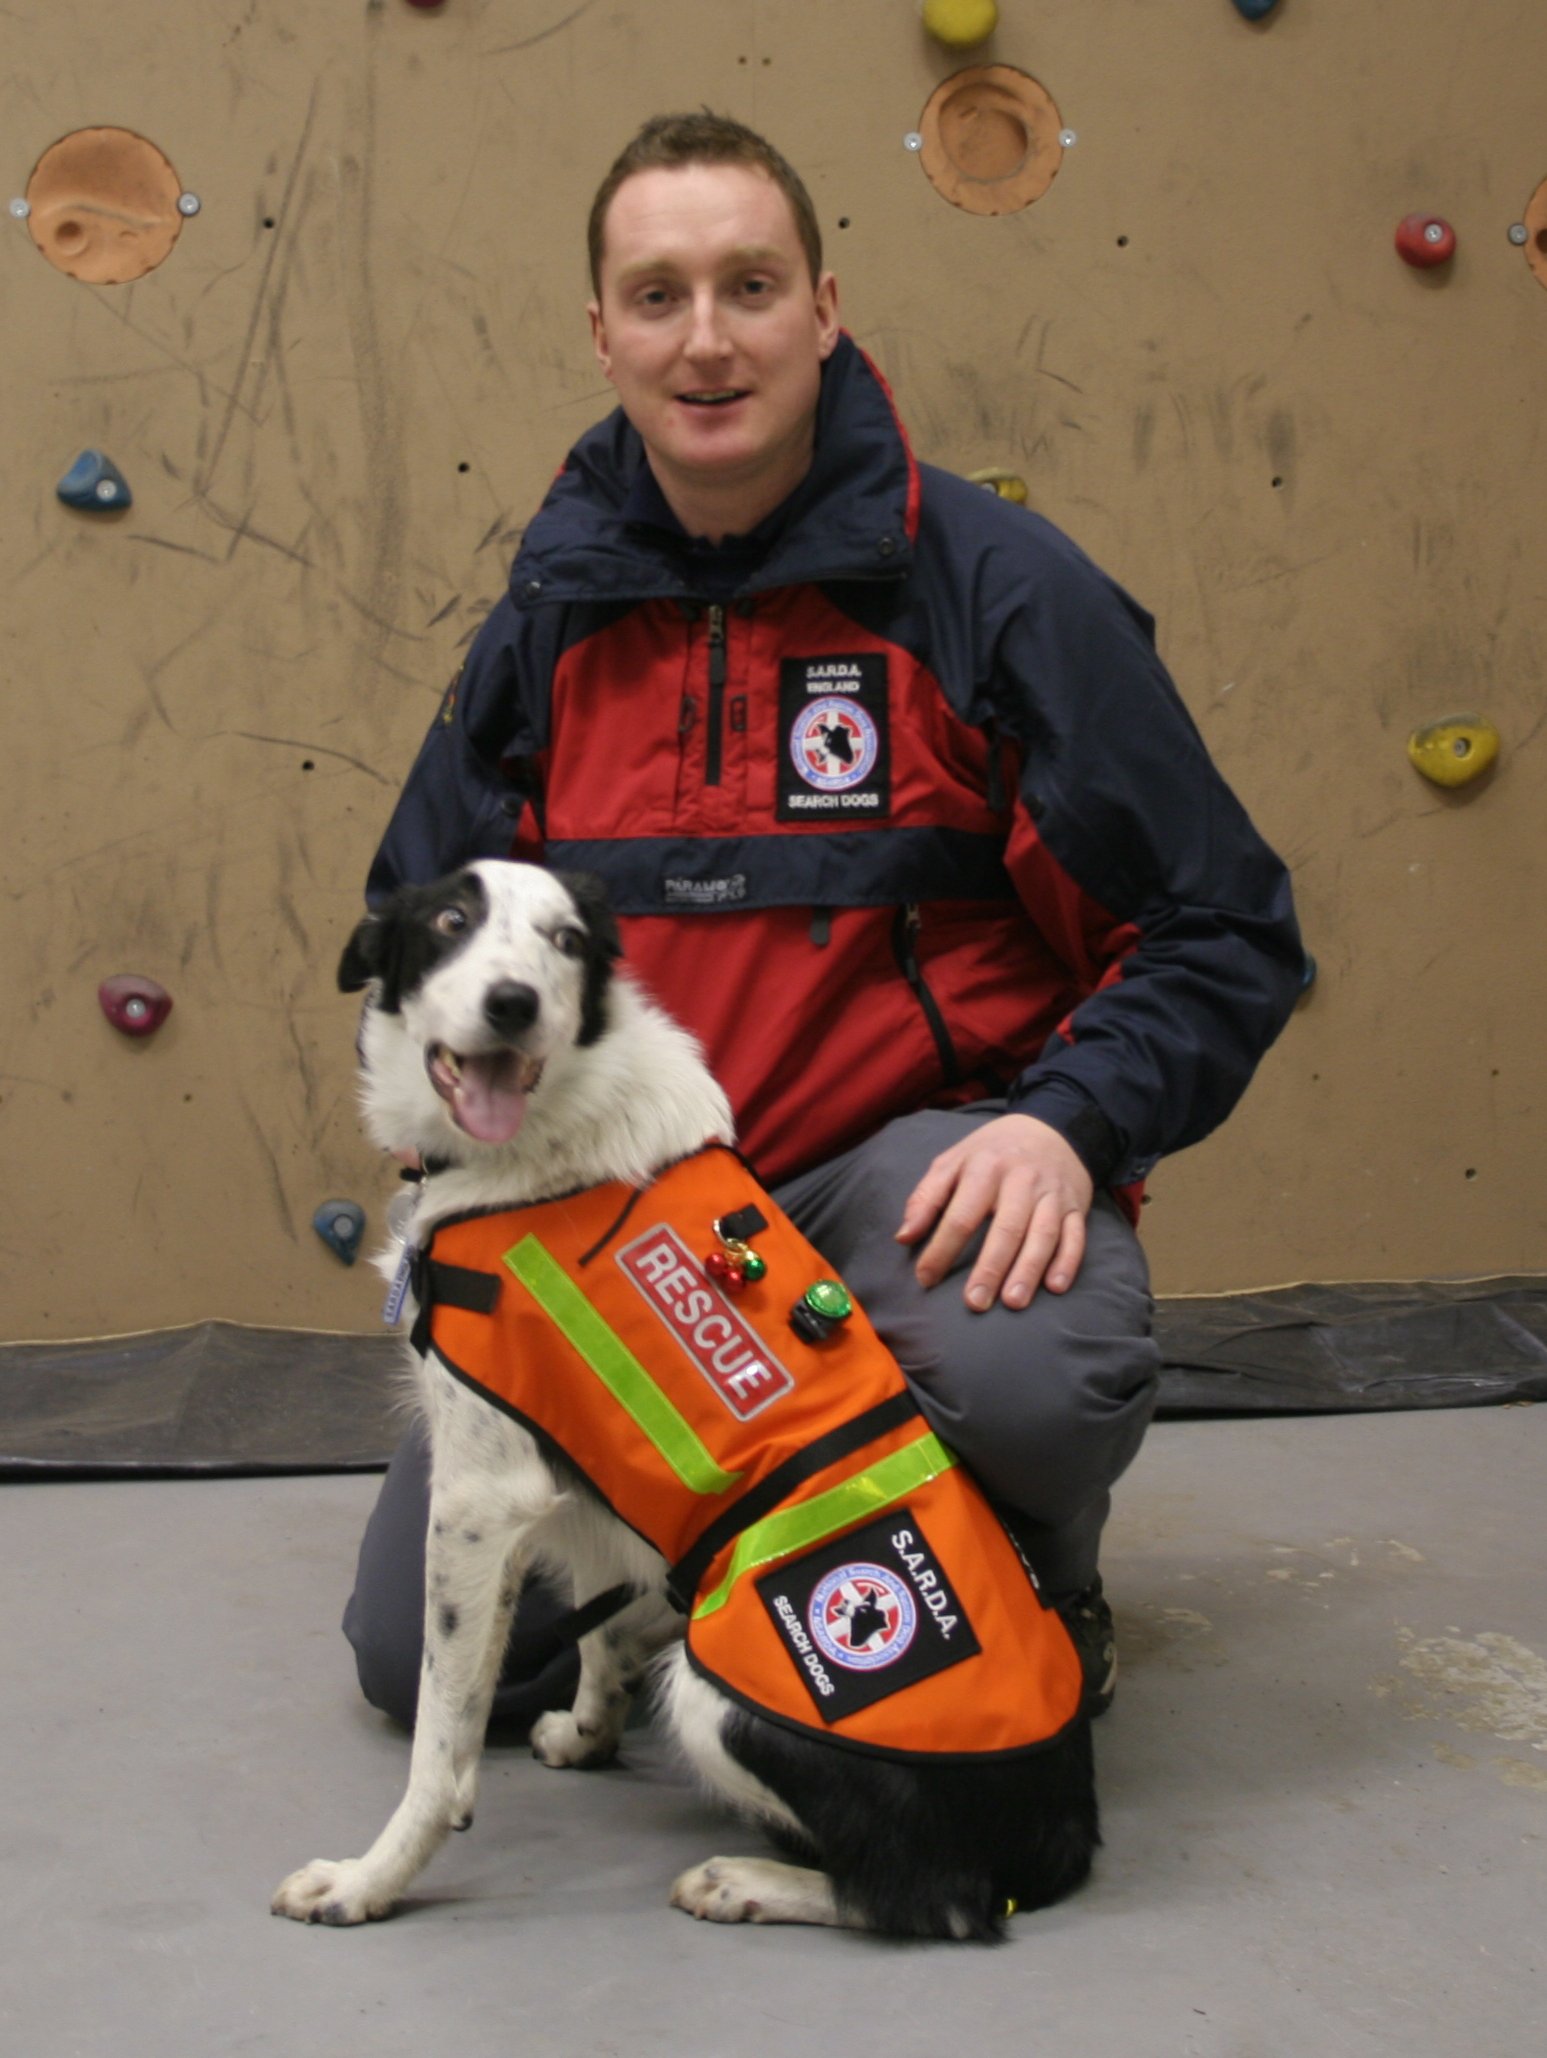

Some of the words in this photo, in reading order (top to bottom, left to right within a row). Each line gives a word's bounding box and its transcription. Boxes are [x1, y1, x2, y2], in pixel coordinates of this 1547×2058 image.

[806, 681, 860, 693] ENGLAND
[788, 795, 839, 808] SEARCH
[841, 794, 879, 807] DOGS
[636, 1243, 772, 1400] RESCUE
[892, 1530, 957, 1640] S.A.R.D.A.
[773, 1595, 813, 1655] SEARCH
[803, 1654, 835, 1696] DOGS
